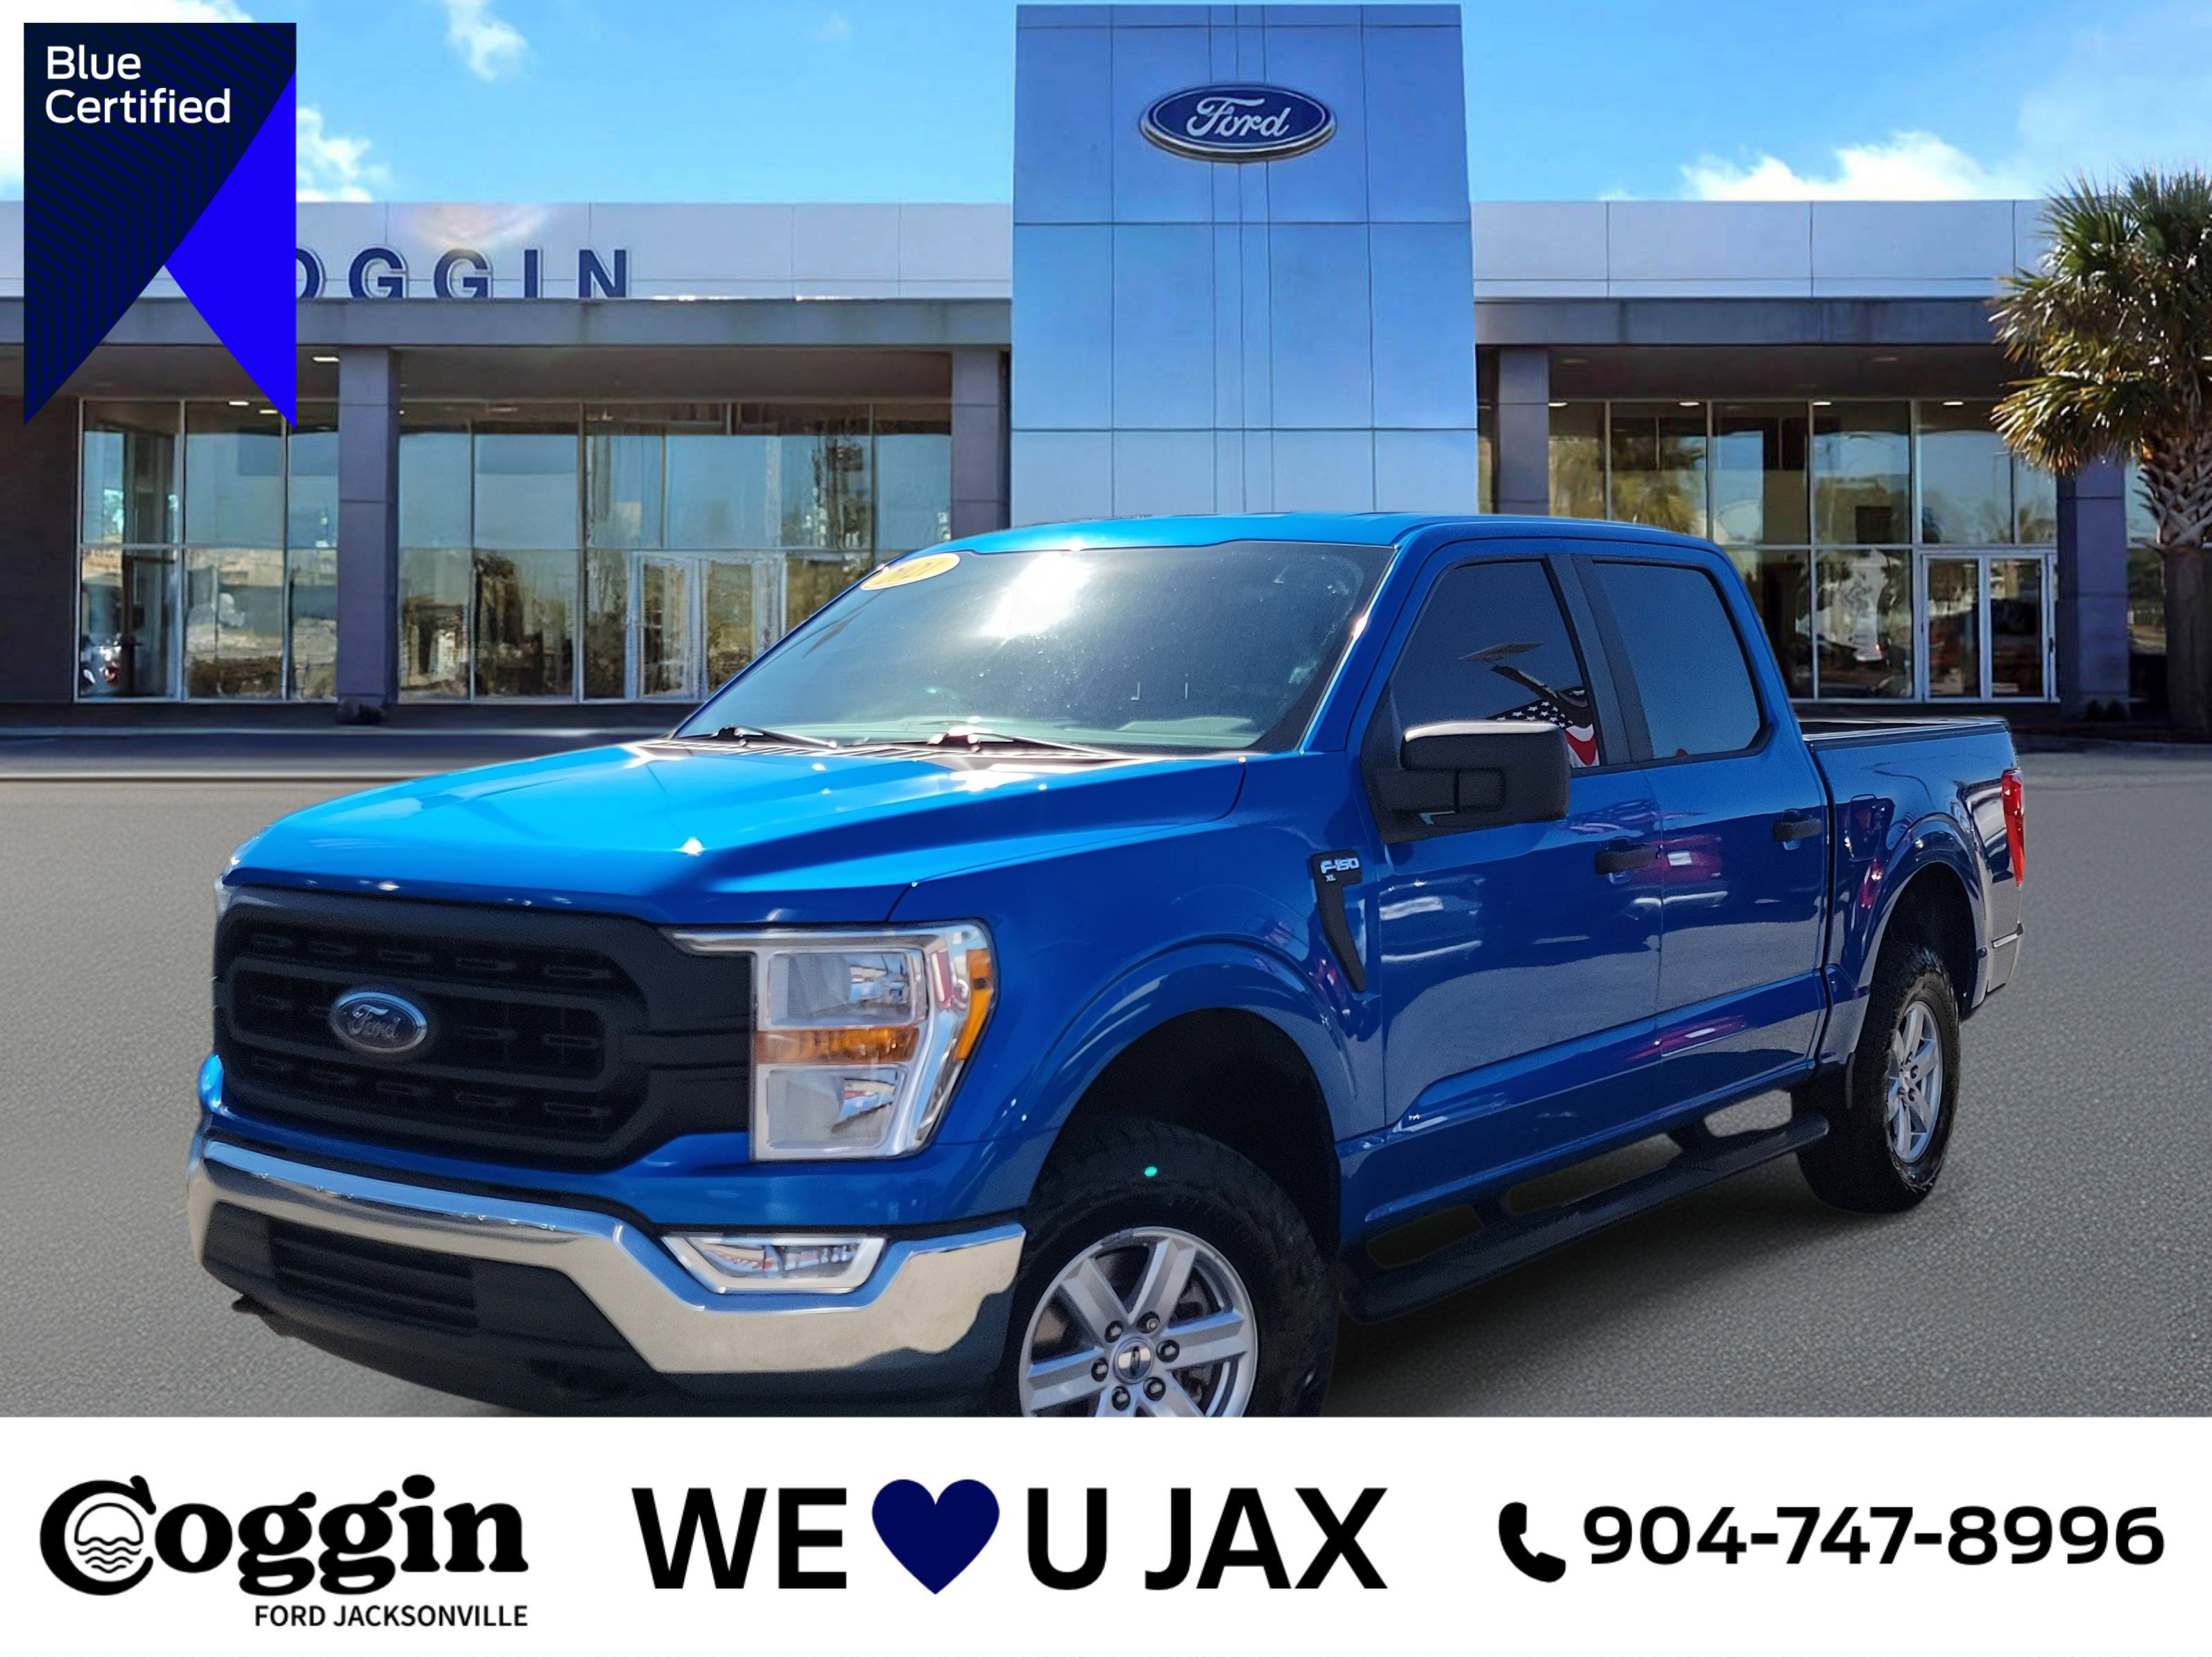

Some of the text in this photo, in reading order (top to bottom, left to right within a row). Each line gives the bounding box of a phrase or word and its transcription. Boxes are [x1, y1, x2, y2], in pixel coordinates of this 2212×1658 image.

[1186, 96, 1292, 137] Ford
[1320, 858, 1360, 874] F-150
[348, 1004, 401, 1039] Ford
